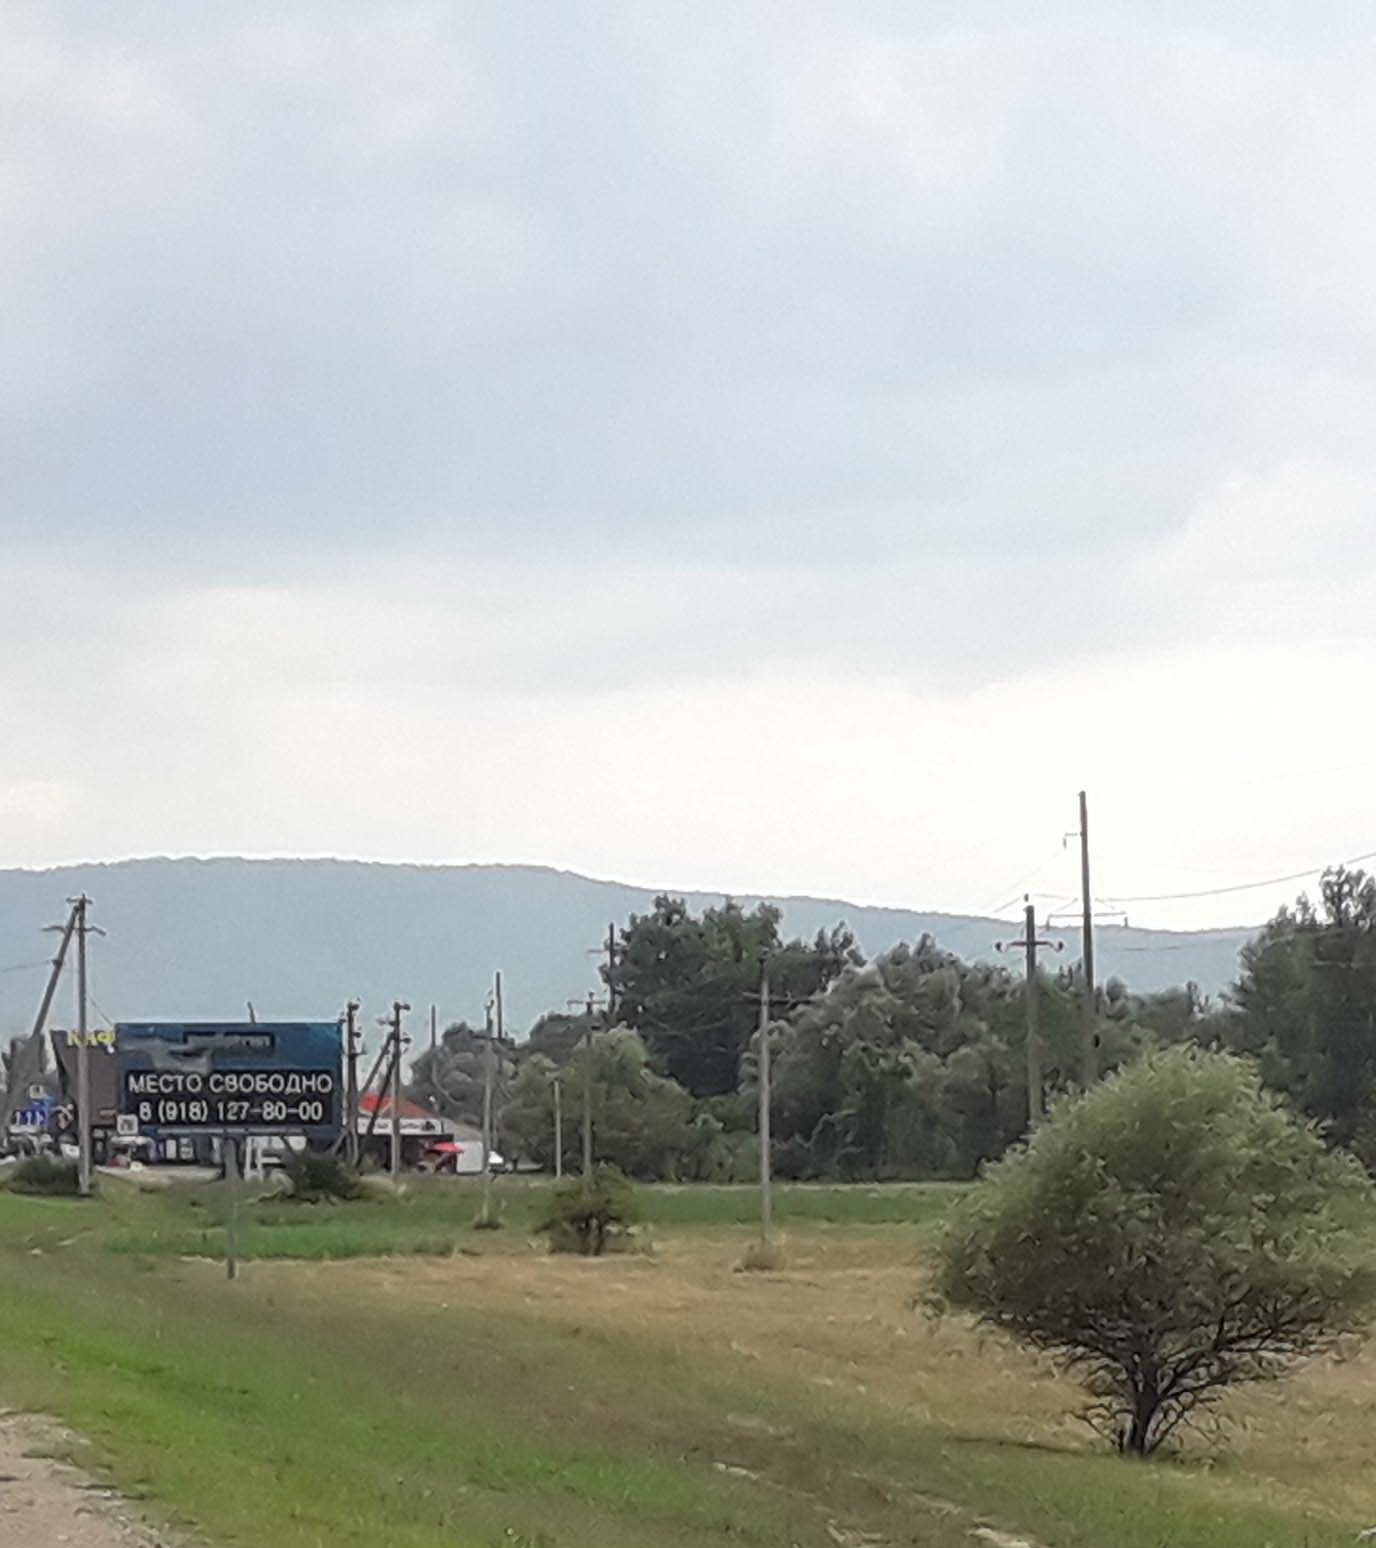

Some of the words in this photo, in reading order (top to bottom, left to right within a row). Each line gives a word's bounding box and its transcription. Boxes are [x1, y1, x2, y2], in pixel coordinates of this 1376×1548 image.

[128, 1074, 202, 1093] МЕСТО
[209, 1073, 333, 1095] СВОБОДНО
[139, 1102, 152, 1121] 8
[158, 1101, 208, 1123] (918)
[217, 1102, 323, 1121] 127-80-00
